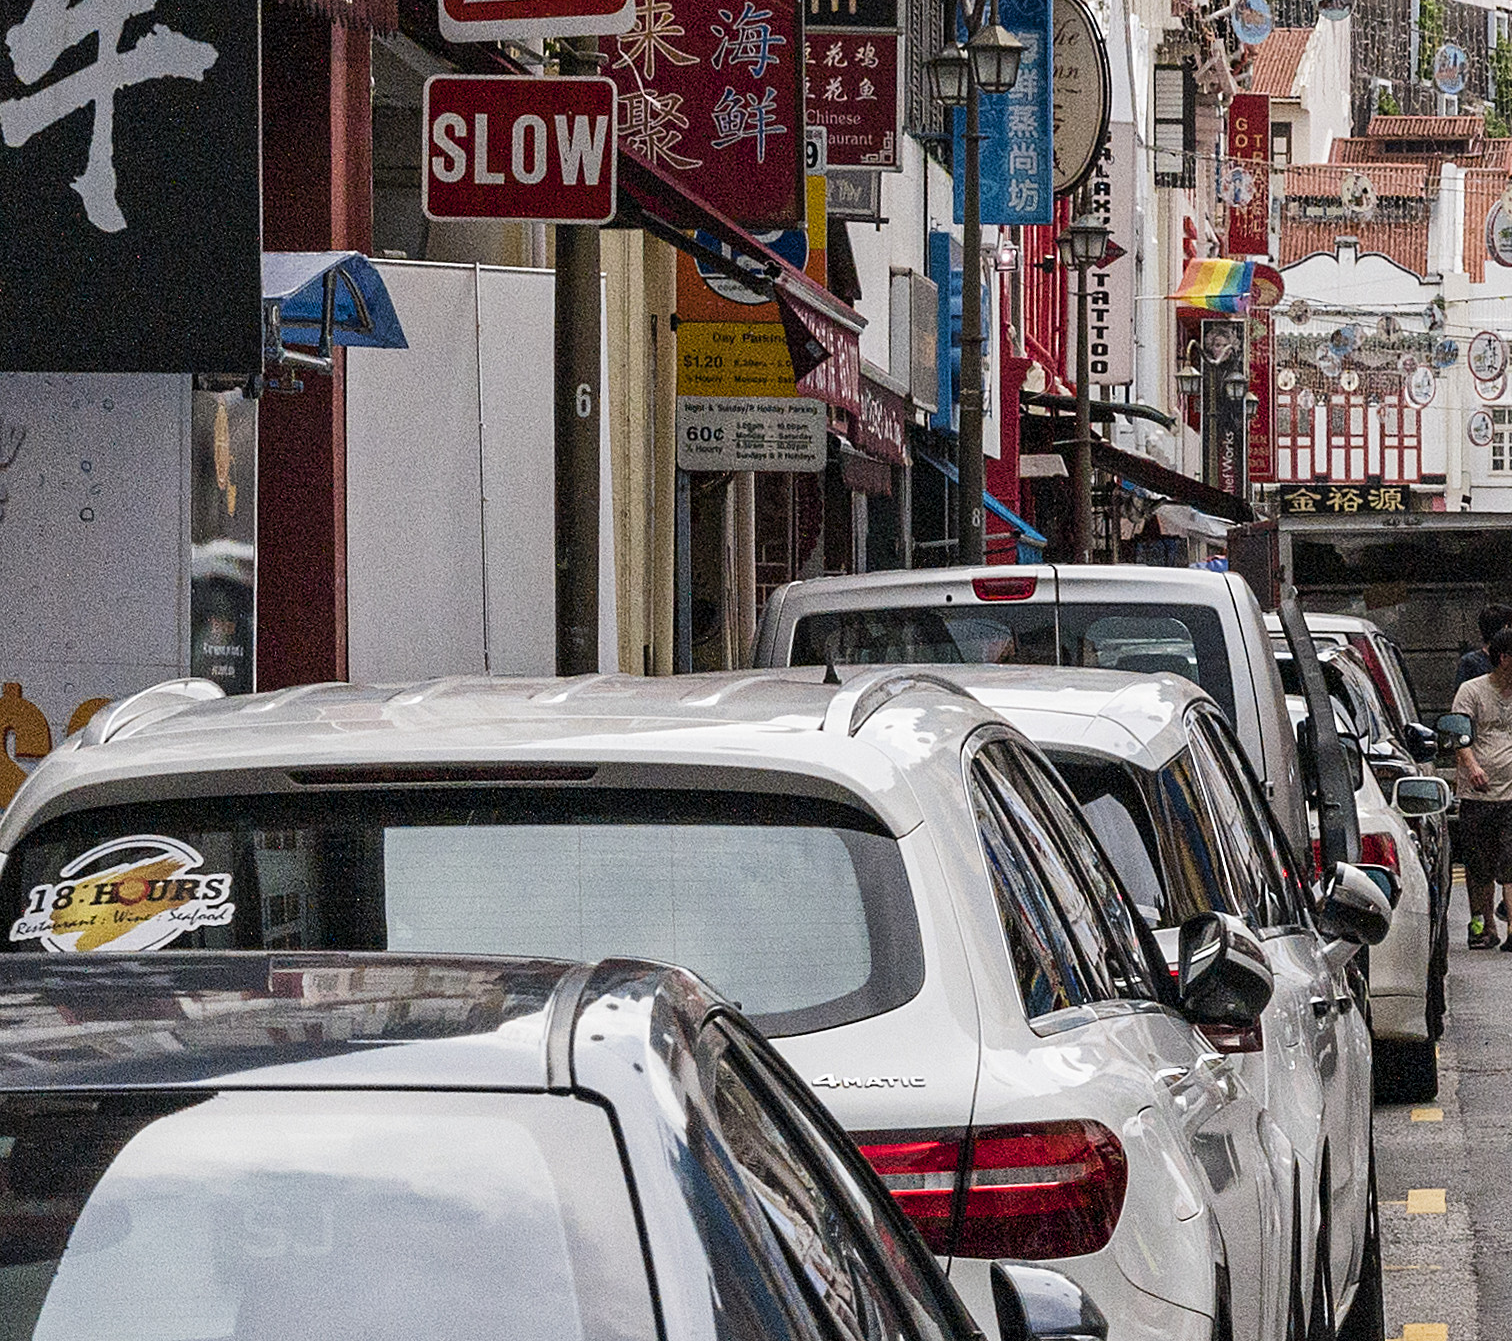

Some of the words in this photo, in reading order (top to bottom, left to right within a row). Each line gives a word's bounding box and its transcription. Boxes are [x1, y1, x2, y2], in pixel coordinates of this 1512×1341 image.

[806, 109, 861, 125] Chinese
[431, 112, 609, 186] SLOW
[829, 134, 873, 146] aurant
[1091, 272, 1111, 374] TATTOO
[684, 355, 723, 368] $1.20
[575, 383, 592, 419] 6
[1222, 430, 1235, 467] Works
[1223, 470, 1236, 496] hef
[1284, 487, 1406, 512] 金裕源
[16, 915, 97, 936] Restaurant
[114, 910, 150, 924] Wine
[168, 908, 227, 926] Seafood
[811, 1071, 926, 1090] 4MATIC
